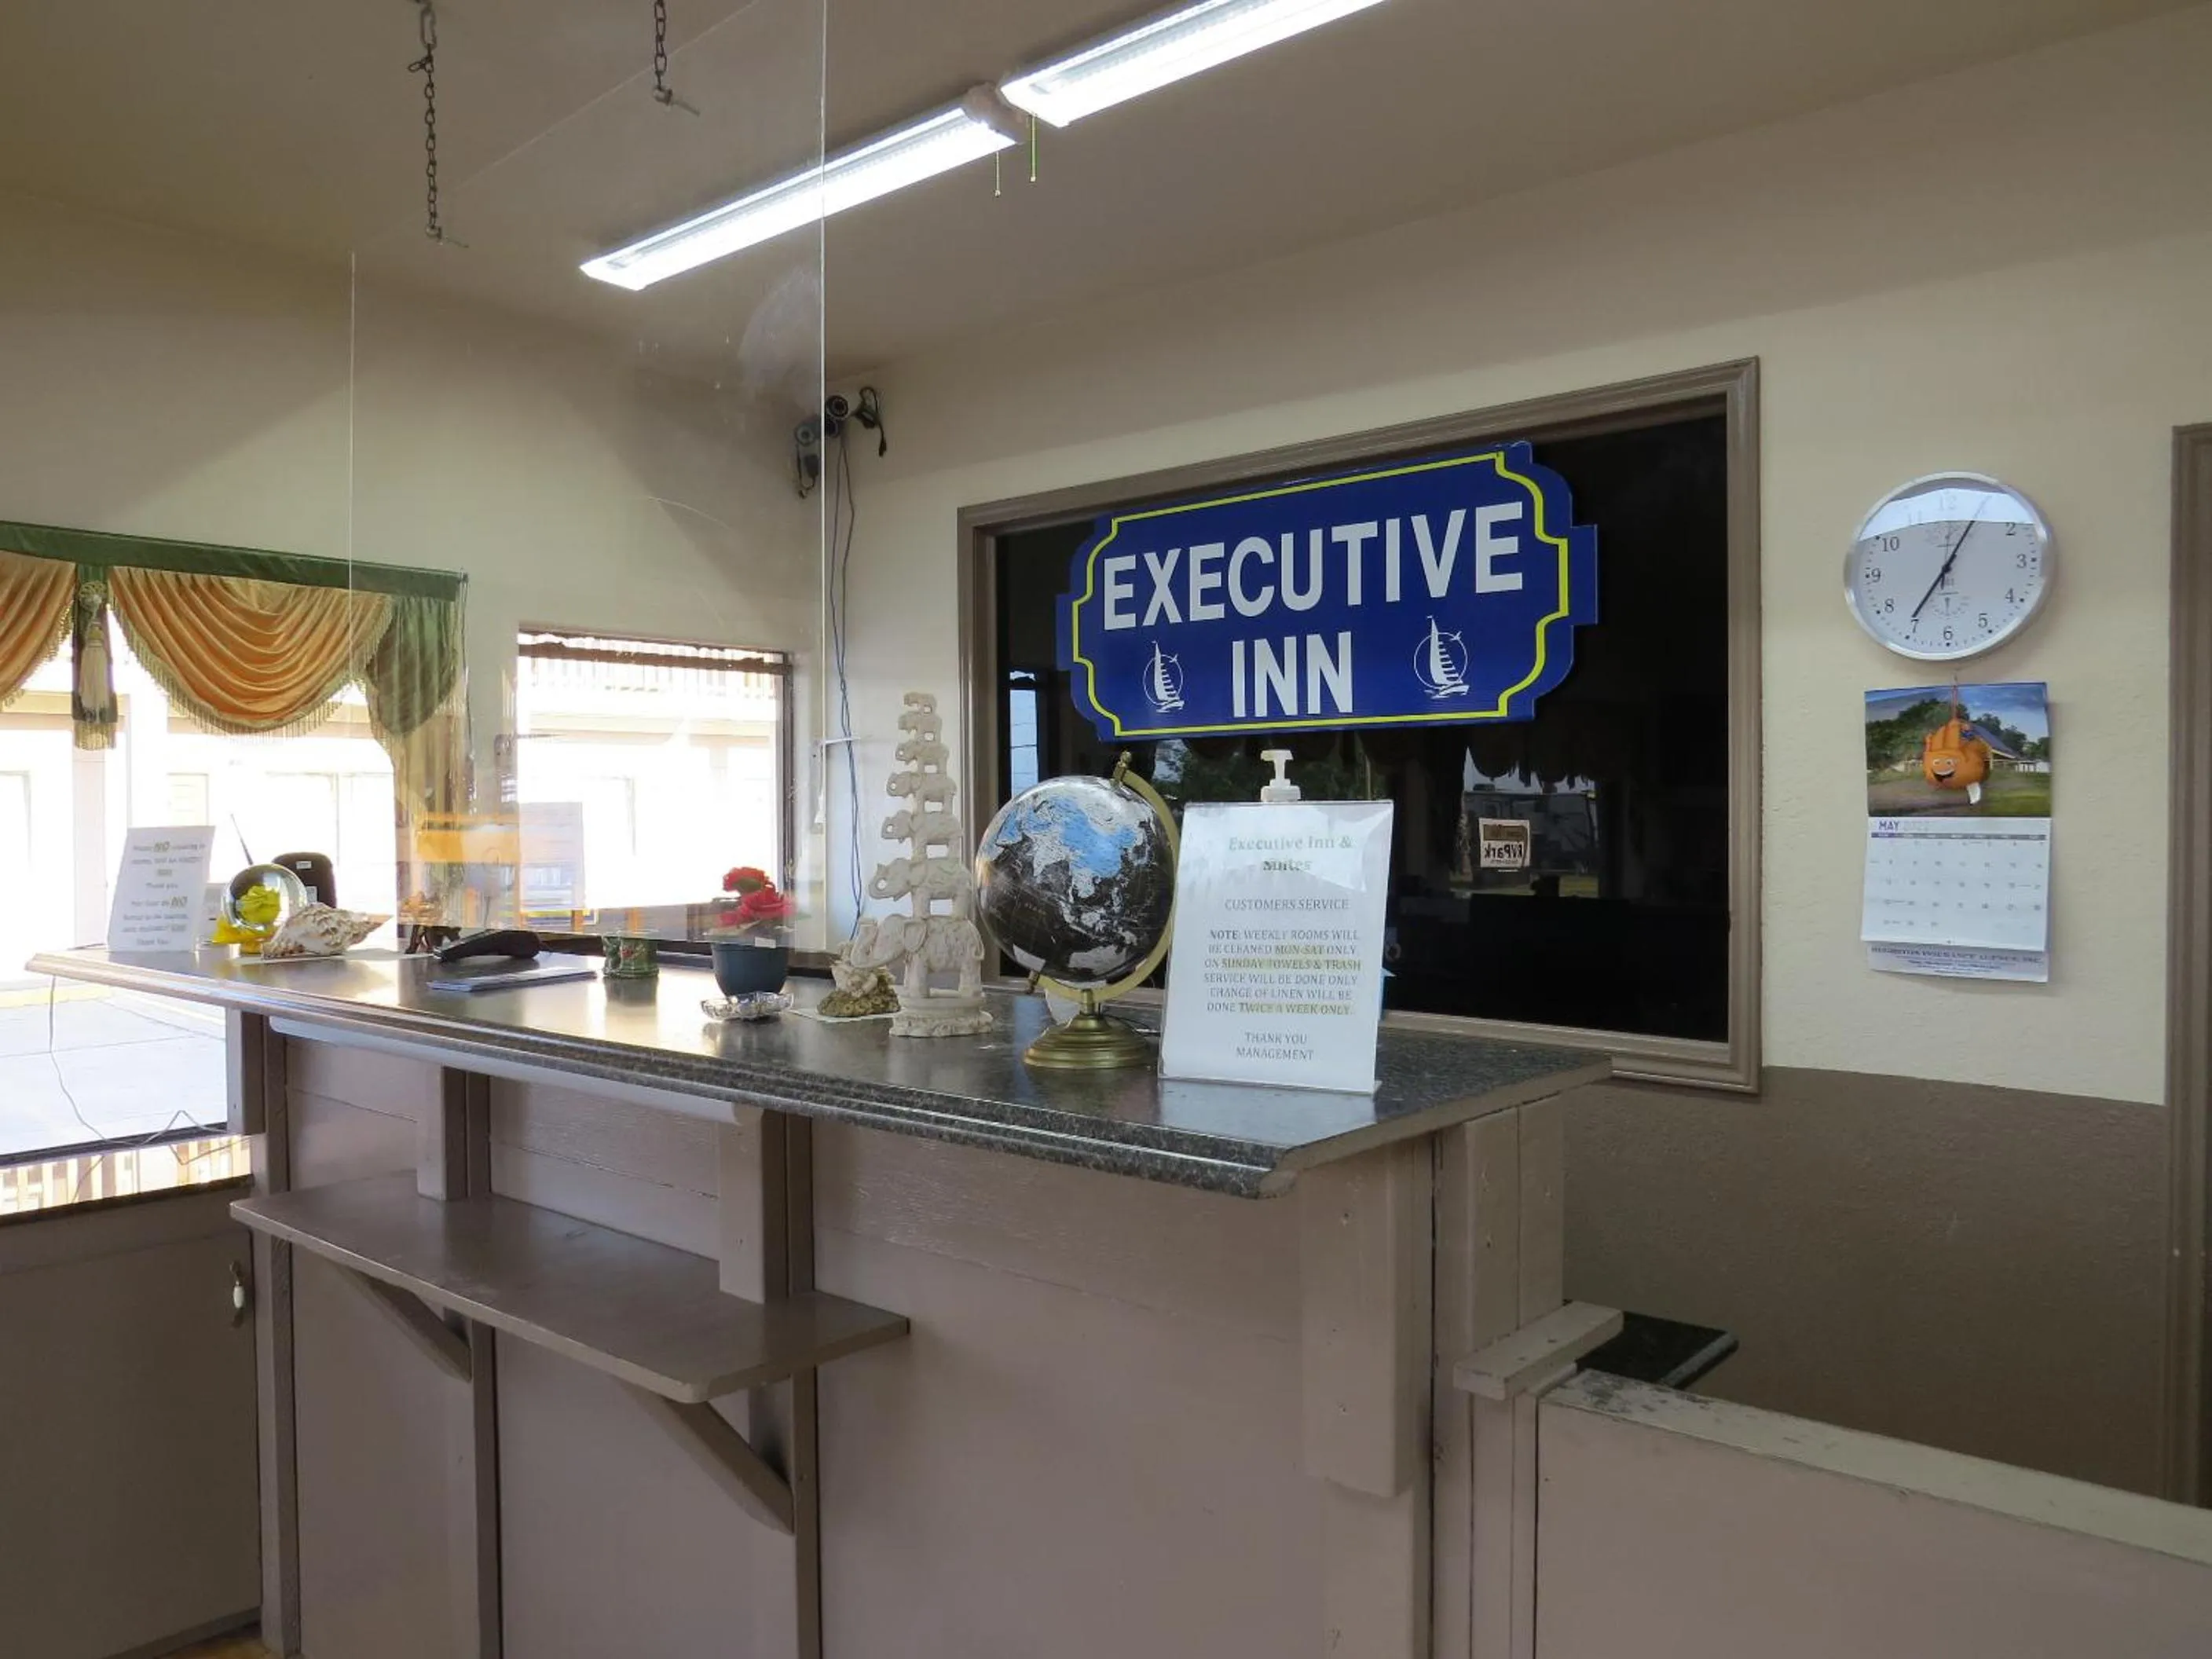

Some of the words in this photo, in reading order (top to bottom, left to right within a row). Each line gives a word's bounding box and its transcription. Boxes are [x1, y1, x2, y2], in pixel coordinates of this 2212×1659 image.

[2005, 522, 2016, 536] 2
[1881, 537, 1900, 552] 10
[1104, 500, 1523, 630] EXECUTIVE
[2016, 554, 2027, 569] 3
[1870, 567, 1881, 583] 9
[2005, 588, 2014, 603] 4
[1884, 599, 1895, 613] 8
[1910, 617, 1920, 633] 7
[1978, 613, 1988, 628] 5
[1943, 626, 1954, 641] 6
[1232, 631, 1353, 718] INN
[1878, 820, 1899, 831] MAY
[1229, 836, 1303, 851] Executive
[1308, 835, 1335, 849] Inn
[1339, 835, 1353, 848] &
[1225, 898, 1297, 910] CUSTOMERS
[1298, 898, 1350, 910] SERVICE
[1243, 930, 1288, 941] WEEKLY
[1291, 930, 1329, 941] ROOMS
[1331, 930, 1360, 940] WILL
[1208, 944, 1222, 954] BE
[1223, 944, 1273, 955] CLEANED
[1327, 945, 1357, 955] ONLY
[1204, 958, 1220, 969] ON
[1221, 958, 1264, 969] SUNDAY
[1268, 959, 1311, 970] TOWELS
[1313, 960, 1322, 970] &
[1324, 960, 1361, 971] TRASH
[1203, 972, 1246, 983] SERVICE
[1248, 973, 1276, 984] WILL
[1278, 974, 1292, 984] BE
[1295, 974, 1325, 985] DONE
[1328, 975, 1358, 986] ONLY
[1210, 987, 1253, 998] CHANGE
[1254, 988, 1269, 999] OF
[1271, 988, 1304, 999] LINEN
[1306, 989, 1335, 1000] WILL
[1338, 990, 1352, 1001] BE
[1207, 1002, 1236, 1013] DONE
[1239, 1003, 1274, 1013] TWICE
[1285, 1004, 1319, 1014] WEEK
[1245, 1031, 1283, 1044] THANK
[1284, 1032, 1307, 1046] YOU
[1236, 1048, 1315, 1061] MANAGEMENT
